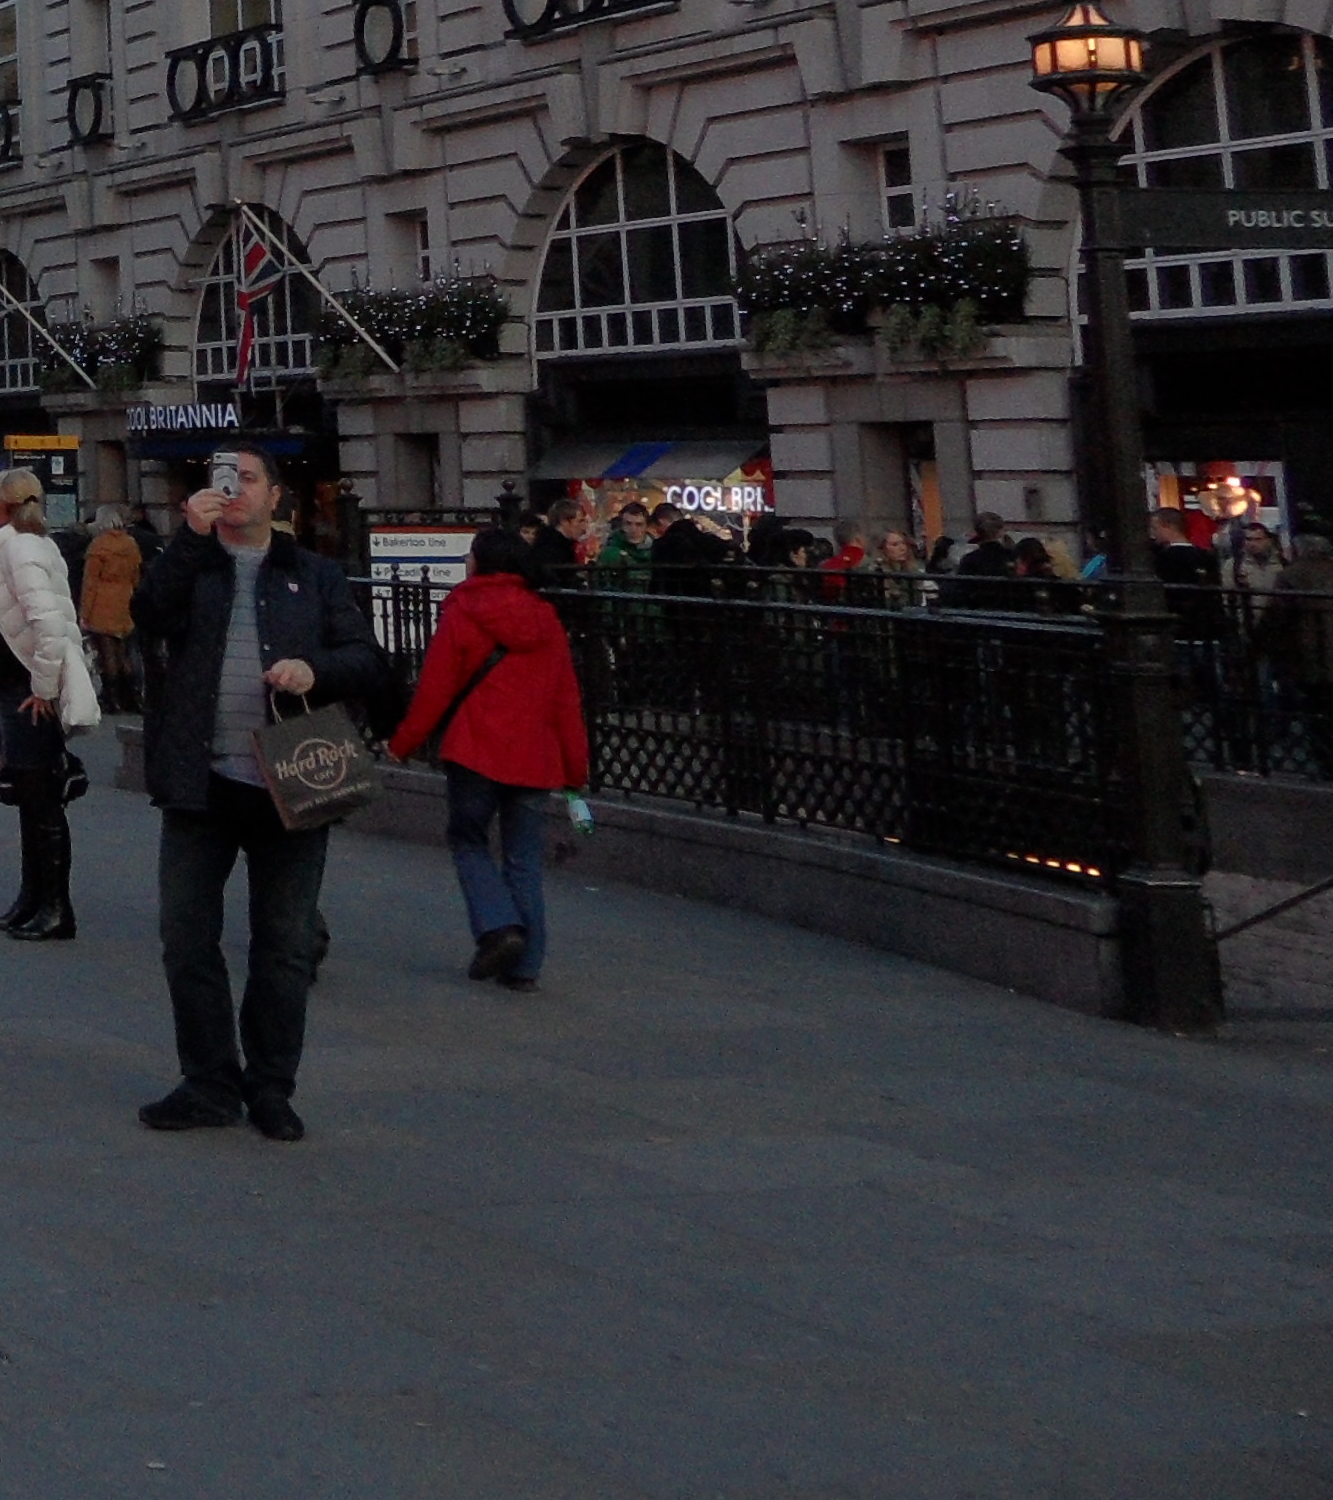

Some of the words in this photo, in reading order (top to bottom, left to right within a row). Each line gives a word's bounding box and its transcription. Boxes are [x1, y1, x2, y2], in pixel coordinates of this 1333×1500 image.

[1228, 210, 1306, 228] PUBLIC
[149, 402, 240, 430] BRITANNIA
[731, 485, 774, 512] BRI
[382, 537, 426, 548] Bakerloo
[428, 537, 447, 547] line
[433, 567, 451, 577] line
[275, 751, 316, 780] Hard
[316, 740, 359, 767] Rock
